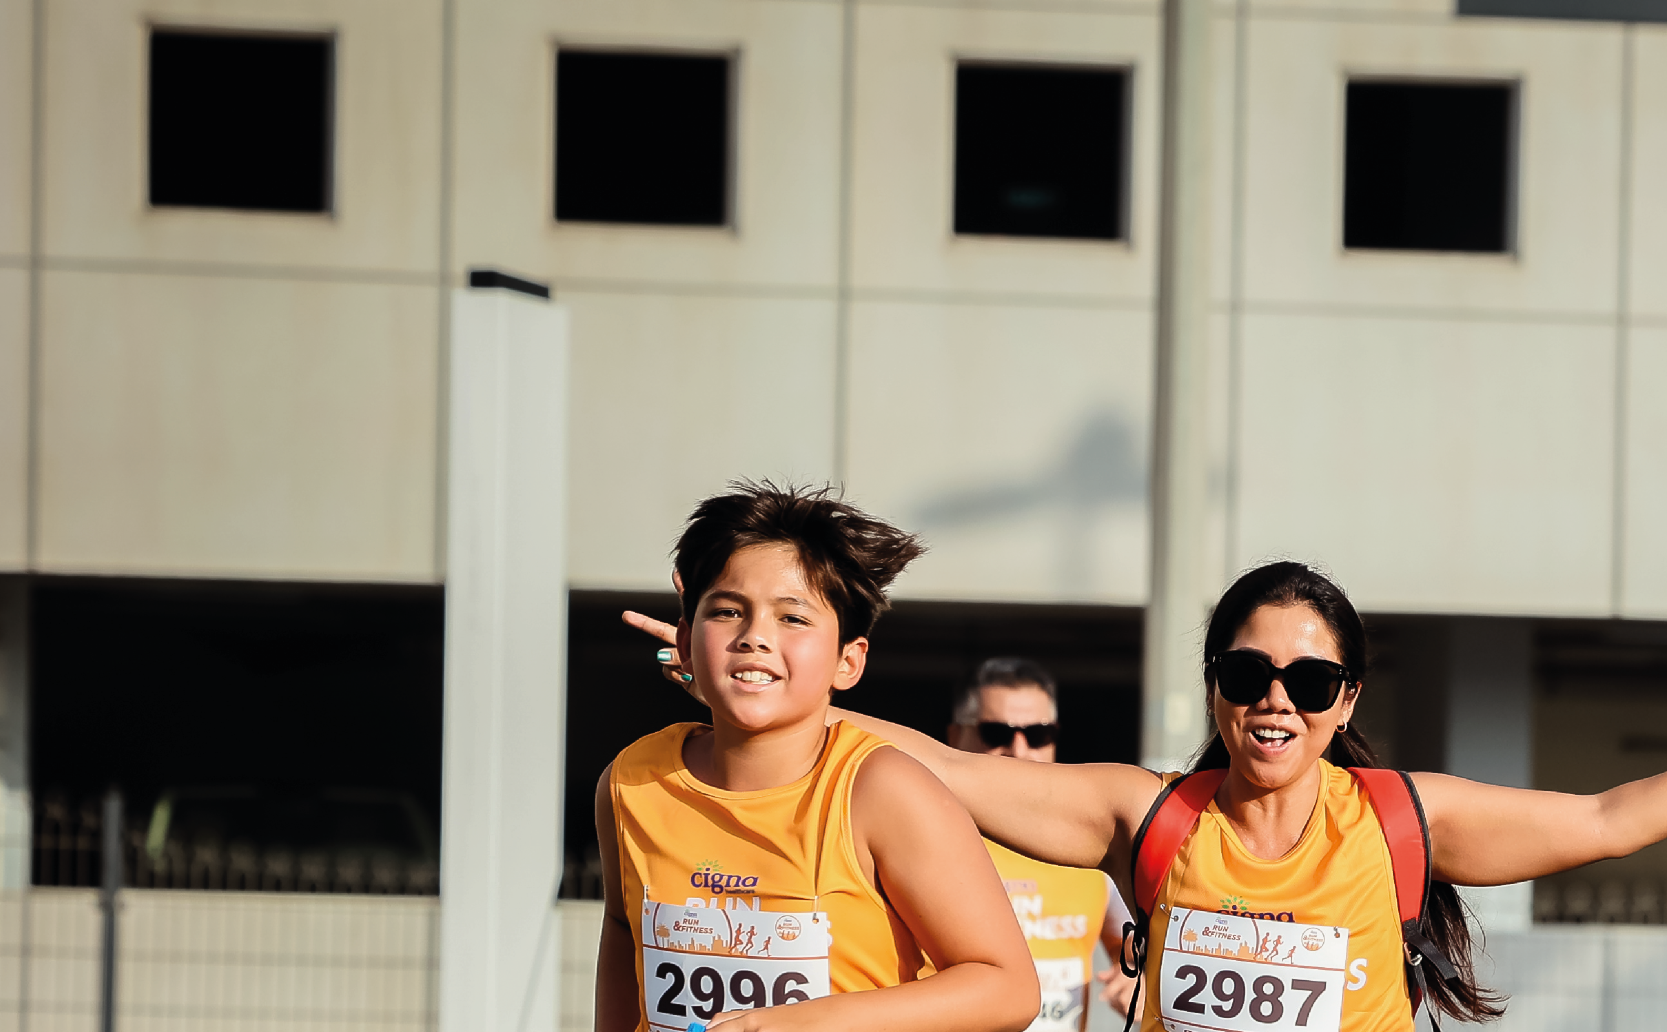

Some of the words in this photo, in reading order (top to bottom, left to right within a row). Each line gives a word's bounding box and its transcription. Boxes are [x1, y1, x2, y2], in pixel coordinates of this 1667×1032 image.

[690, 867, 759, 895] cigna
[682, 918, 700, 926] RUN
[1021, 914, 1088, 940] NESS
[1212, 924, 1230, 933] RUN
[655, 962, 810, 1021] 2996
[1172, 964, 1328, 1027] 2987
